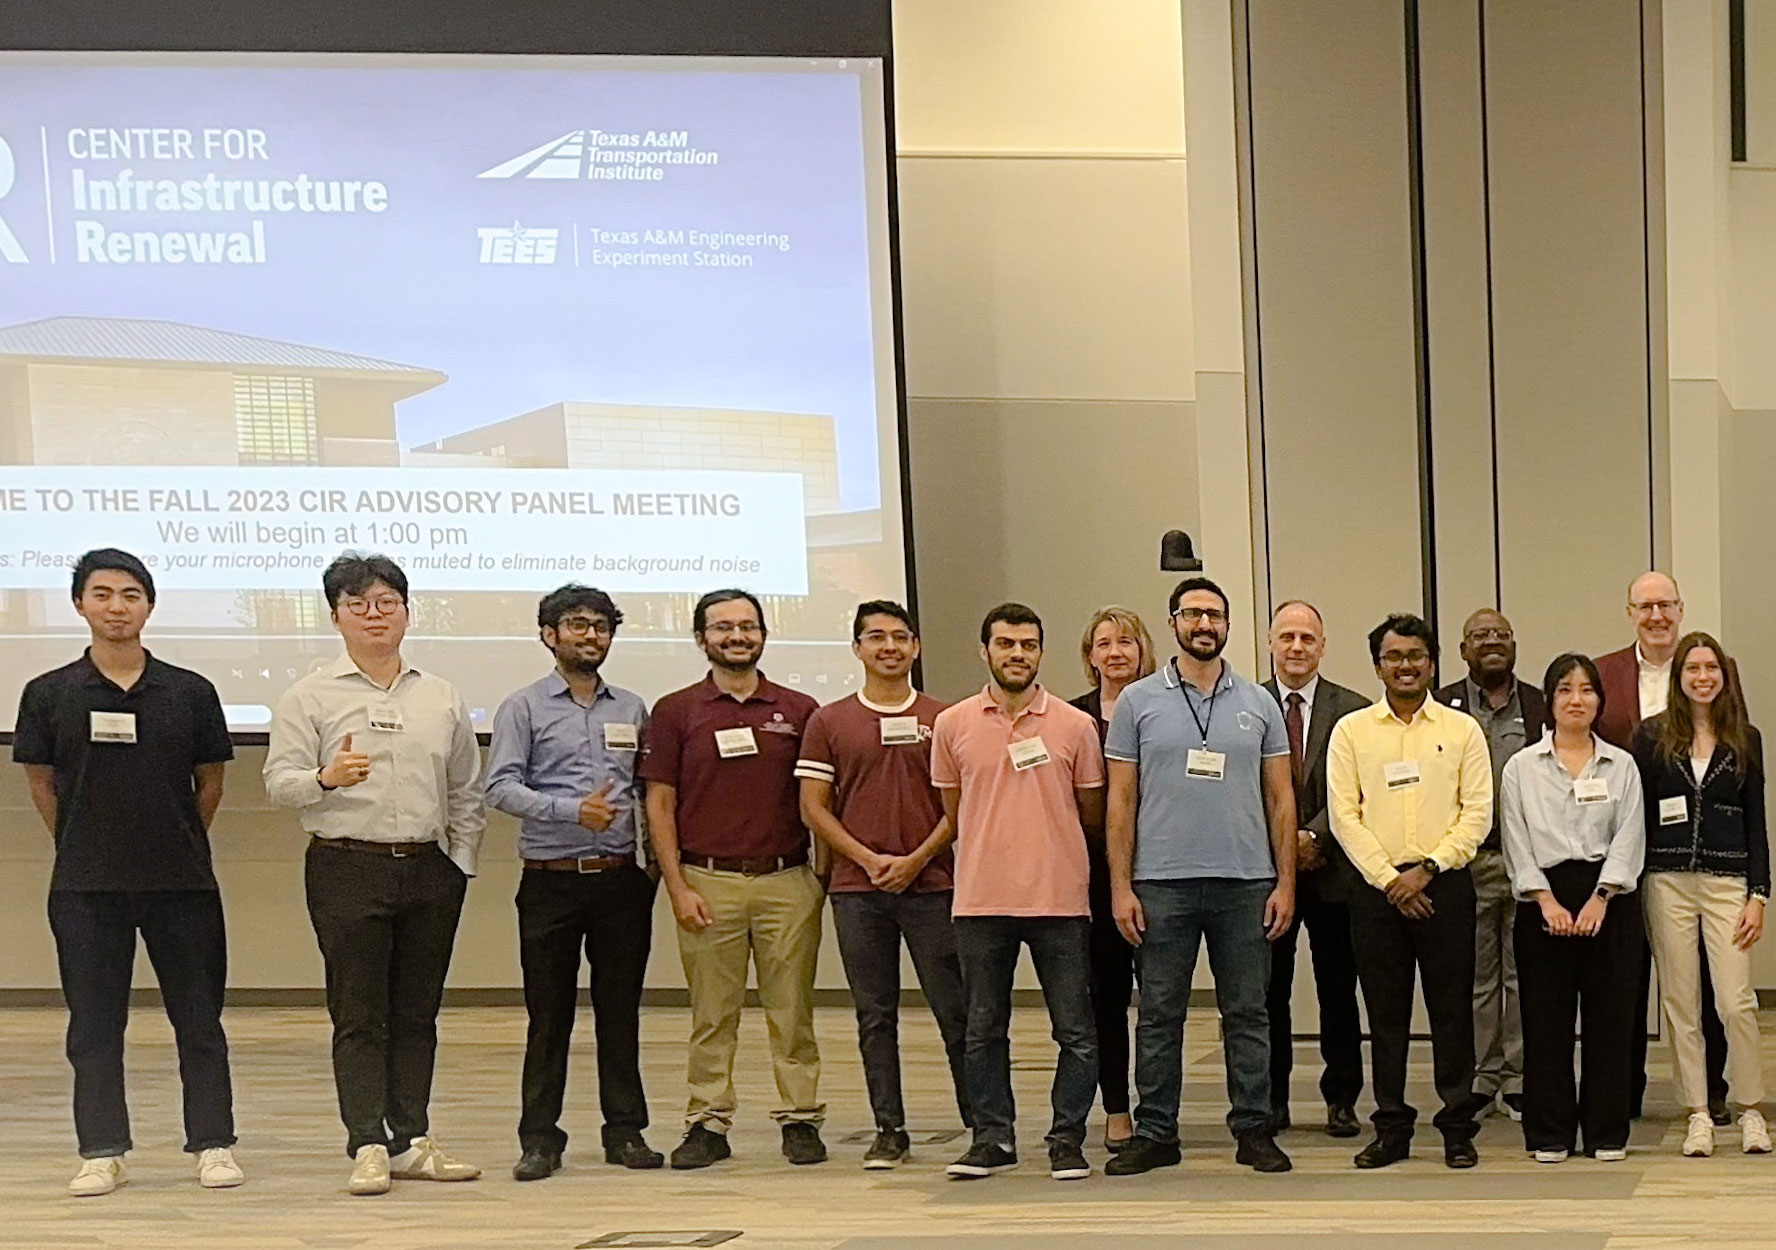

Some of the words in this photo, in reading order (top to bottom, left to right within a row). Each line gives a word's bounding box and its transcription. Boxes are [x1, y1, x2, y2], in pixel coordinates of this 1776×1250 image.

[68, 128, 195, 160] CENTER
[203, 128, 269, 161] FOR
[589, 129, 640, 147] Texas
[642, 130, 688, 148] A&M
[587, 146, 718, 166] Transportation
[587, 163, 664, 181] Institute
[71, 168, 388, 213] Infrastructure
[75, 219, 267, 264] Renewal
[477, 227, 558, 264] TEES
[589, 227, 639, 245] Texas
[642, 229, 684, 245] A&M
[688, 229, 790, 252] Engineering
[592, 248, 689, 269] Experiment
[693, 250, 753, 267] Station
[34, 488, 74, 512] TO
[81, 488, 140, 512] THE
[148, 489, 220, 513] FALL
[227, 489, 290, 513] 2023
[300, 490, 347, 513] CIR
[354, 490, 502, 514] ADVISORY
[510, 491, 605, 515] PANEL
[612, 492, 741, 517] MEETING
[156, 520, 200, 544] We
[207, 520, 247, 544] will
[255, 520, 326, 550] begin
[334, 522, 358, 544] at
[367, 521, 421, 545] 1:00
[429, 527, 468, 551] pm
[22, 549, 81, 568] Pleas
[164, 554, 208, 572] your
[212, 551, 325, 573] microphone
[412, 552, 473, 570] muted
[478, 553, 496, 570] to
[501, 552, 587, 571] eliminate
[592, 553, 705, 576] background
[709, 559, 761, 573] noise
